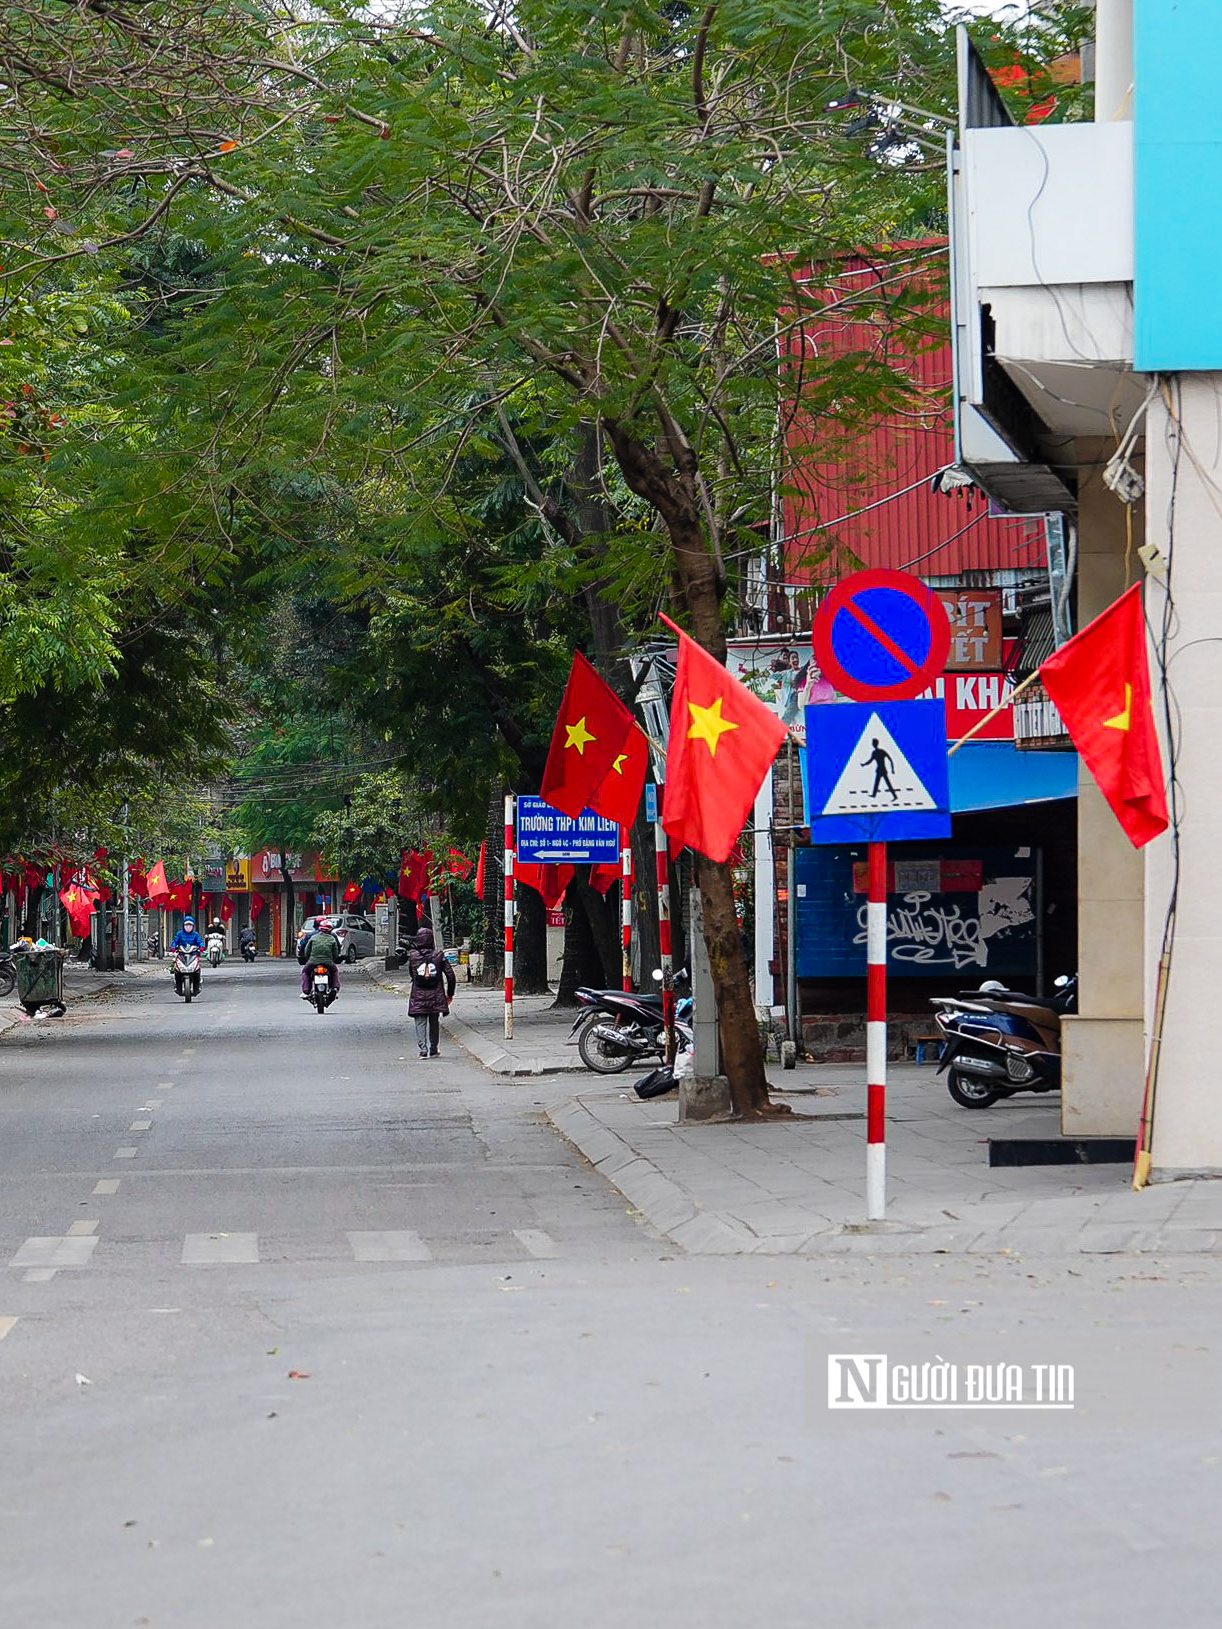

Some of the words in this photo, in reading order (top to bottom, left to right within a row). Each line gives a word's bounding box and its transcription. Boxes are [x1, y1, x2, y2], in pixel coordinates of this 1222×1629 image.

[952, 629, 989, 662] ẾT
[520, 813, 554, 832] TRƯỜNG
[556, 816, 576, 832] THPT
[578, 816, 595, 832] KIM
